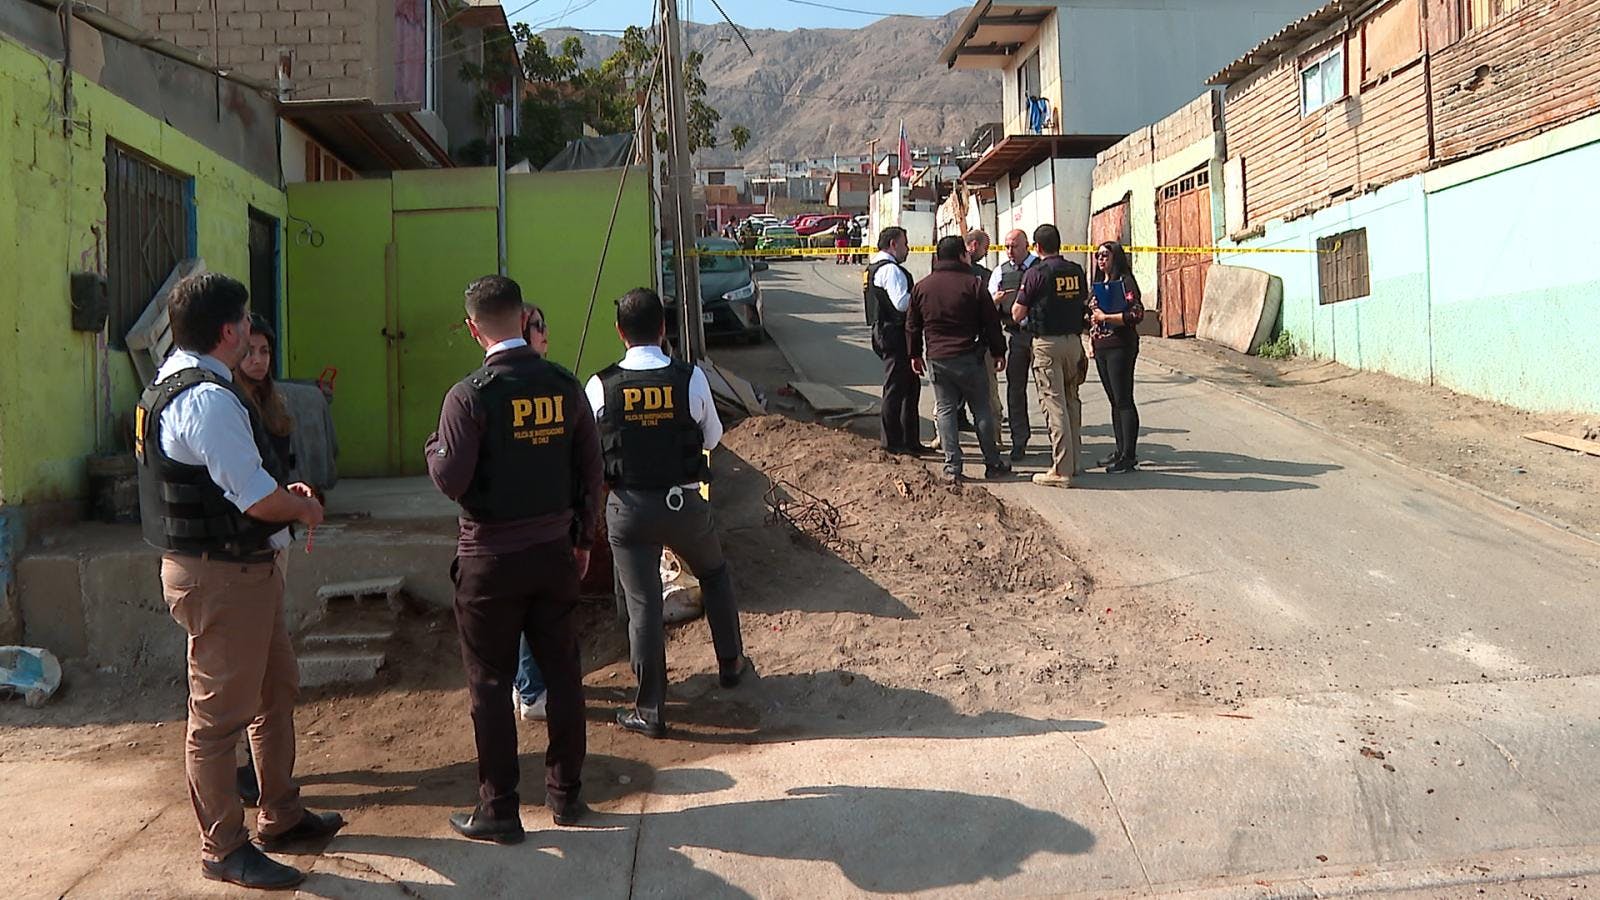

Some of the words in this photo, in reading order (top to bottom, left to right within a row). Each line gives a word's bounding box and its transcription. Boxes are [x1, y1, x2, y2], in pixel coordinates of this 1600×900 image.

[1056, 276, 1079, 291] PDI
[511, 395, 564, 427] PDI
[623, 386, 674, 411] PDI
